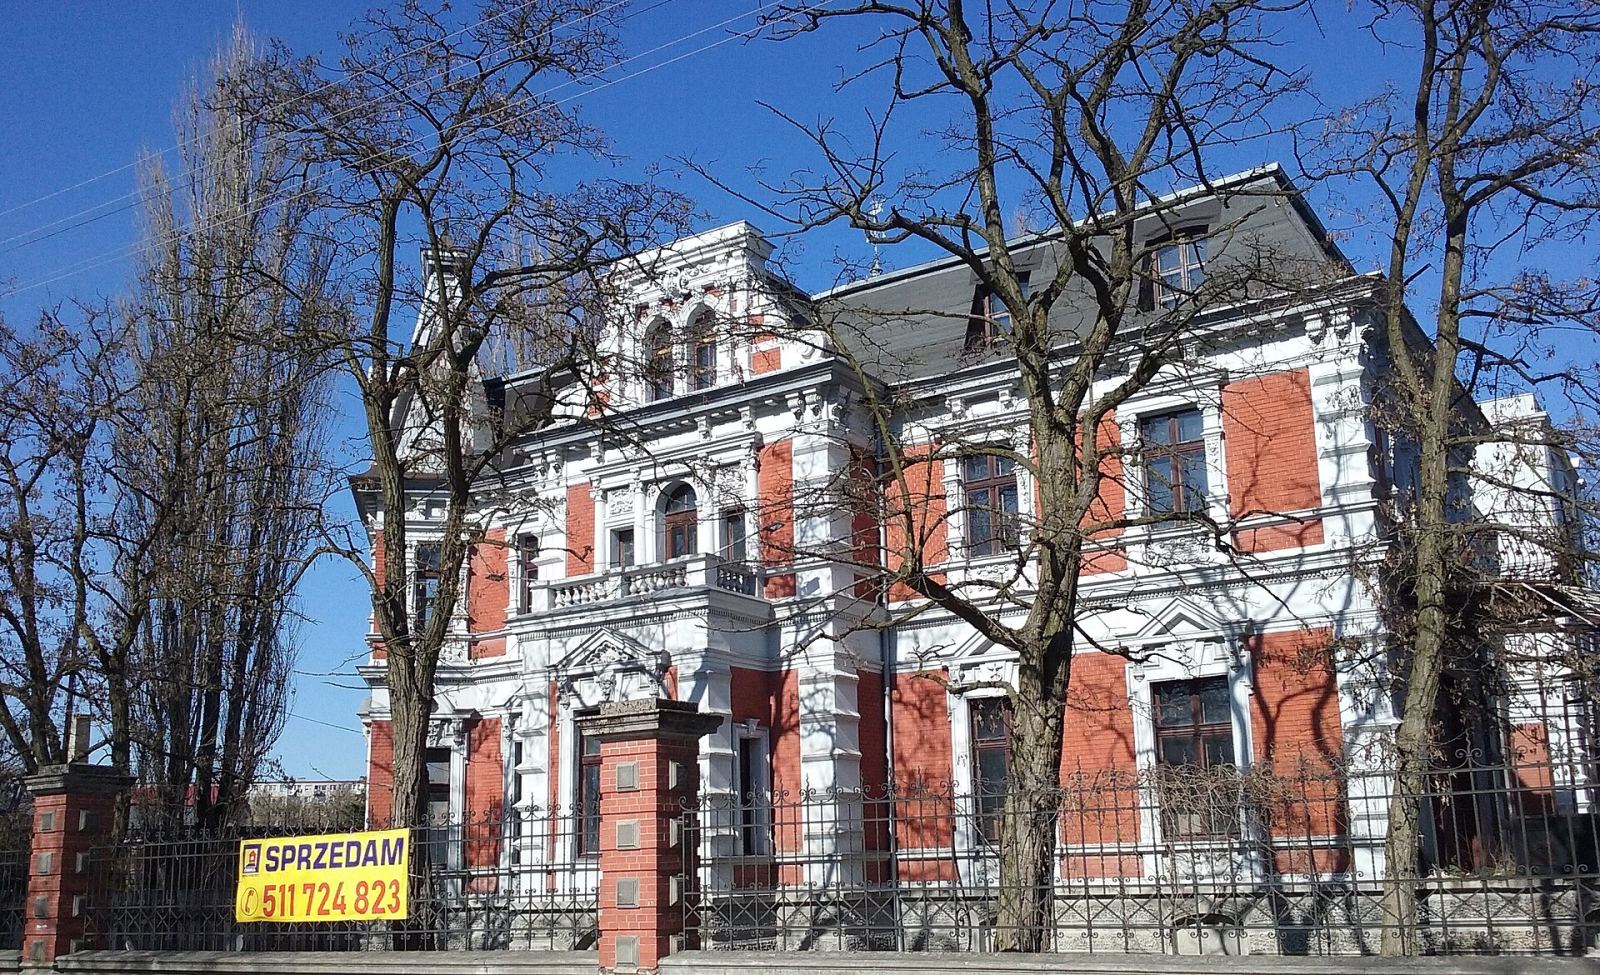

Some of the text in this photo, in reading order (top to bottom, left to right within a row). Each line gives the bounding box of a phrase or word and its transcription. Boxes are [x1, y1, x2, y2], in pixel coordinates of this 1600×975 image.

[265, 837, 404, 872] SPRZEDAM
[262, 879, 400, 917] 511 724 823
